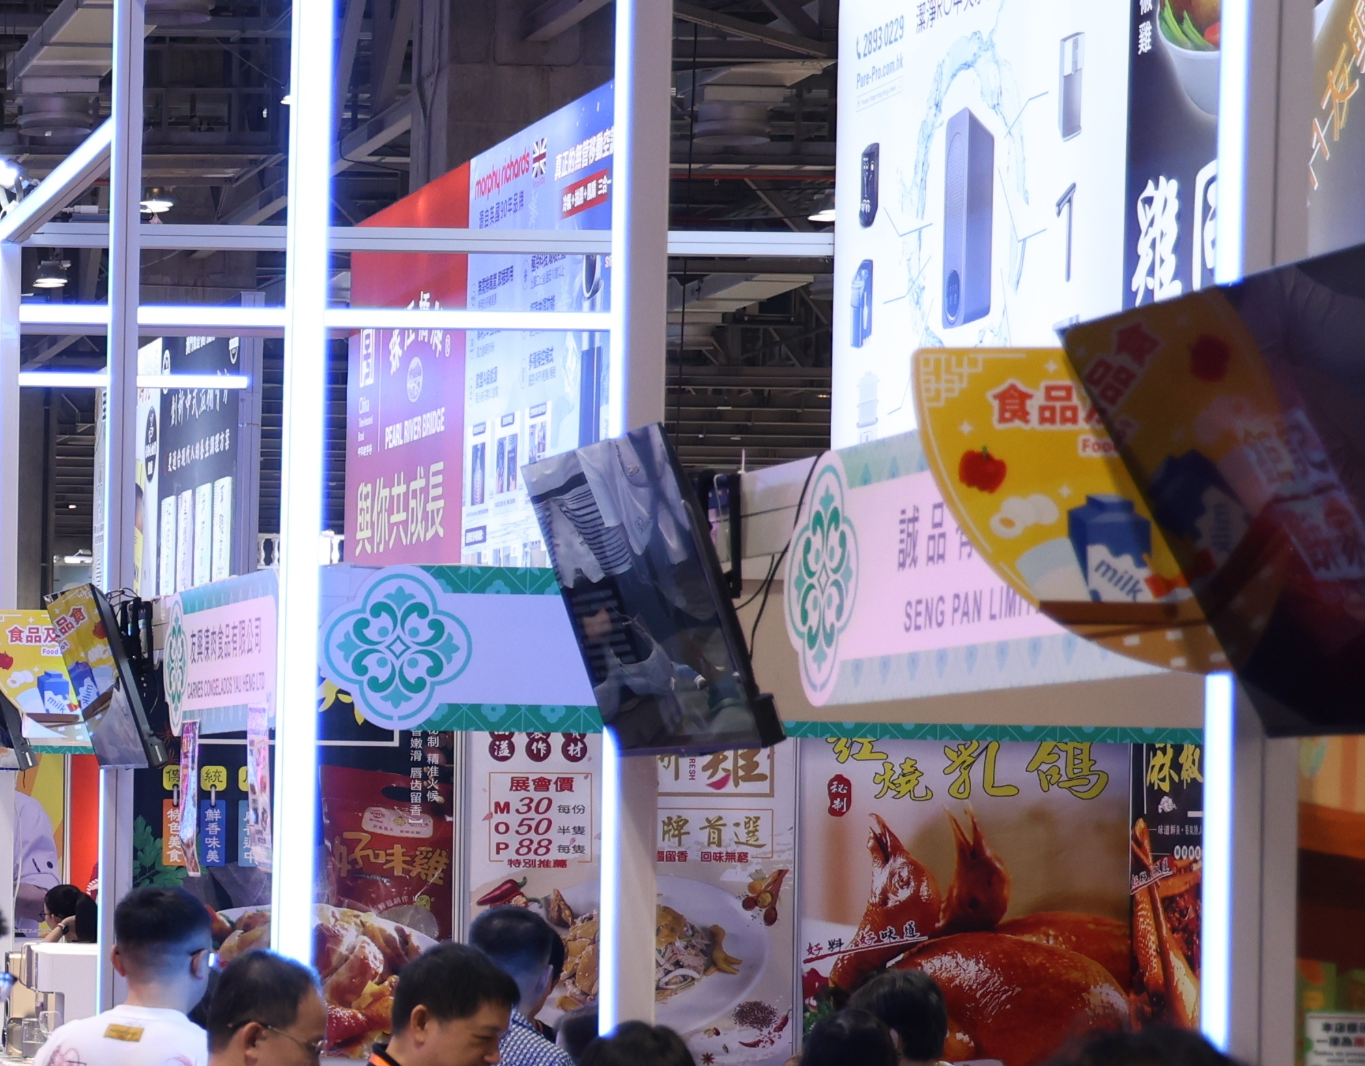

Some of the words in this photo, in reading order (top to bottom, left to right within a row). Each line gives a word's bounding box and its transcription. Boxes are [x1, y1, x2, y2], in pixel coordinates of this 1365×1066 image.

[863, 26, 883, 58] 2893
[884, 15, 905, 47] 0229
[475, 165, 501, 200] morphy
[501, 147, 531, 191] richards
[385, 422, 403, 450] PEARL
[404, 416, 422, 446] RIVER
[422, 407, 445, 440] BRIDGE
[355, 461, 445, 557] 與你共成長
[1093, 558, 1145, 600] milk
[904, 596, 945, 633] SENG
[951, 590, 983, 626] PAN
[46, 696, 67, 713] milk
[494, 801, 511, 815] M
[514, 796, 553, 815] 30
[557, 804, 586, 815] 每份
[509, 776, 575, 793] 展會價
[204, 808, 221, 864] 鮮香味美
[494, 821, 510, 835] O
[514, 817, 553, 836] 50
[495, 842, 510, 856] P
[514, 838, 553, 857] 88
[557, 844, 586, 855] 每隻
[507, 858, 568, 869] 特別推薦
